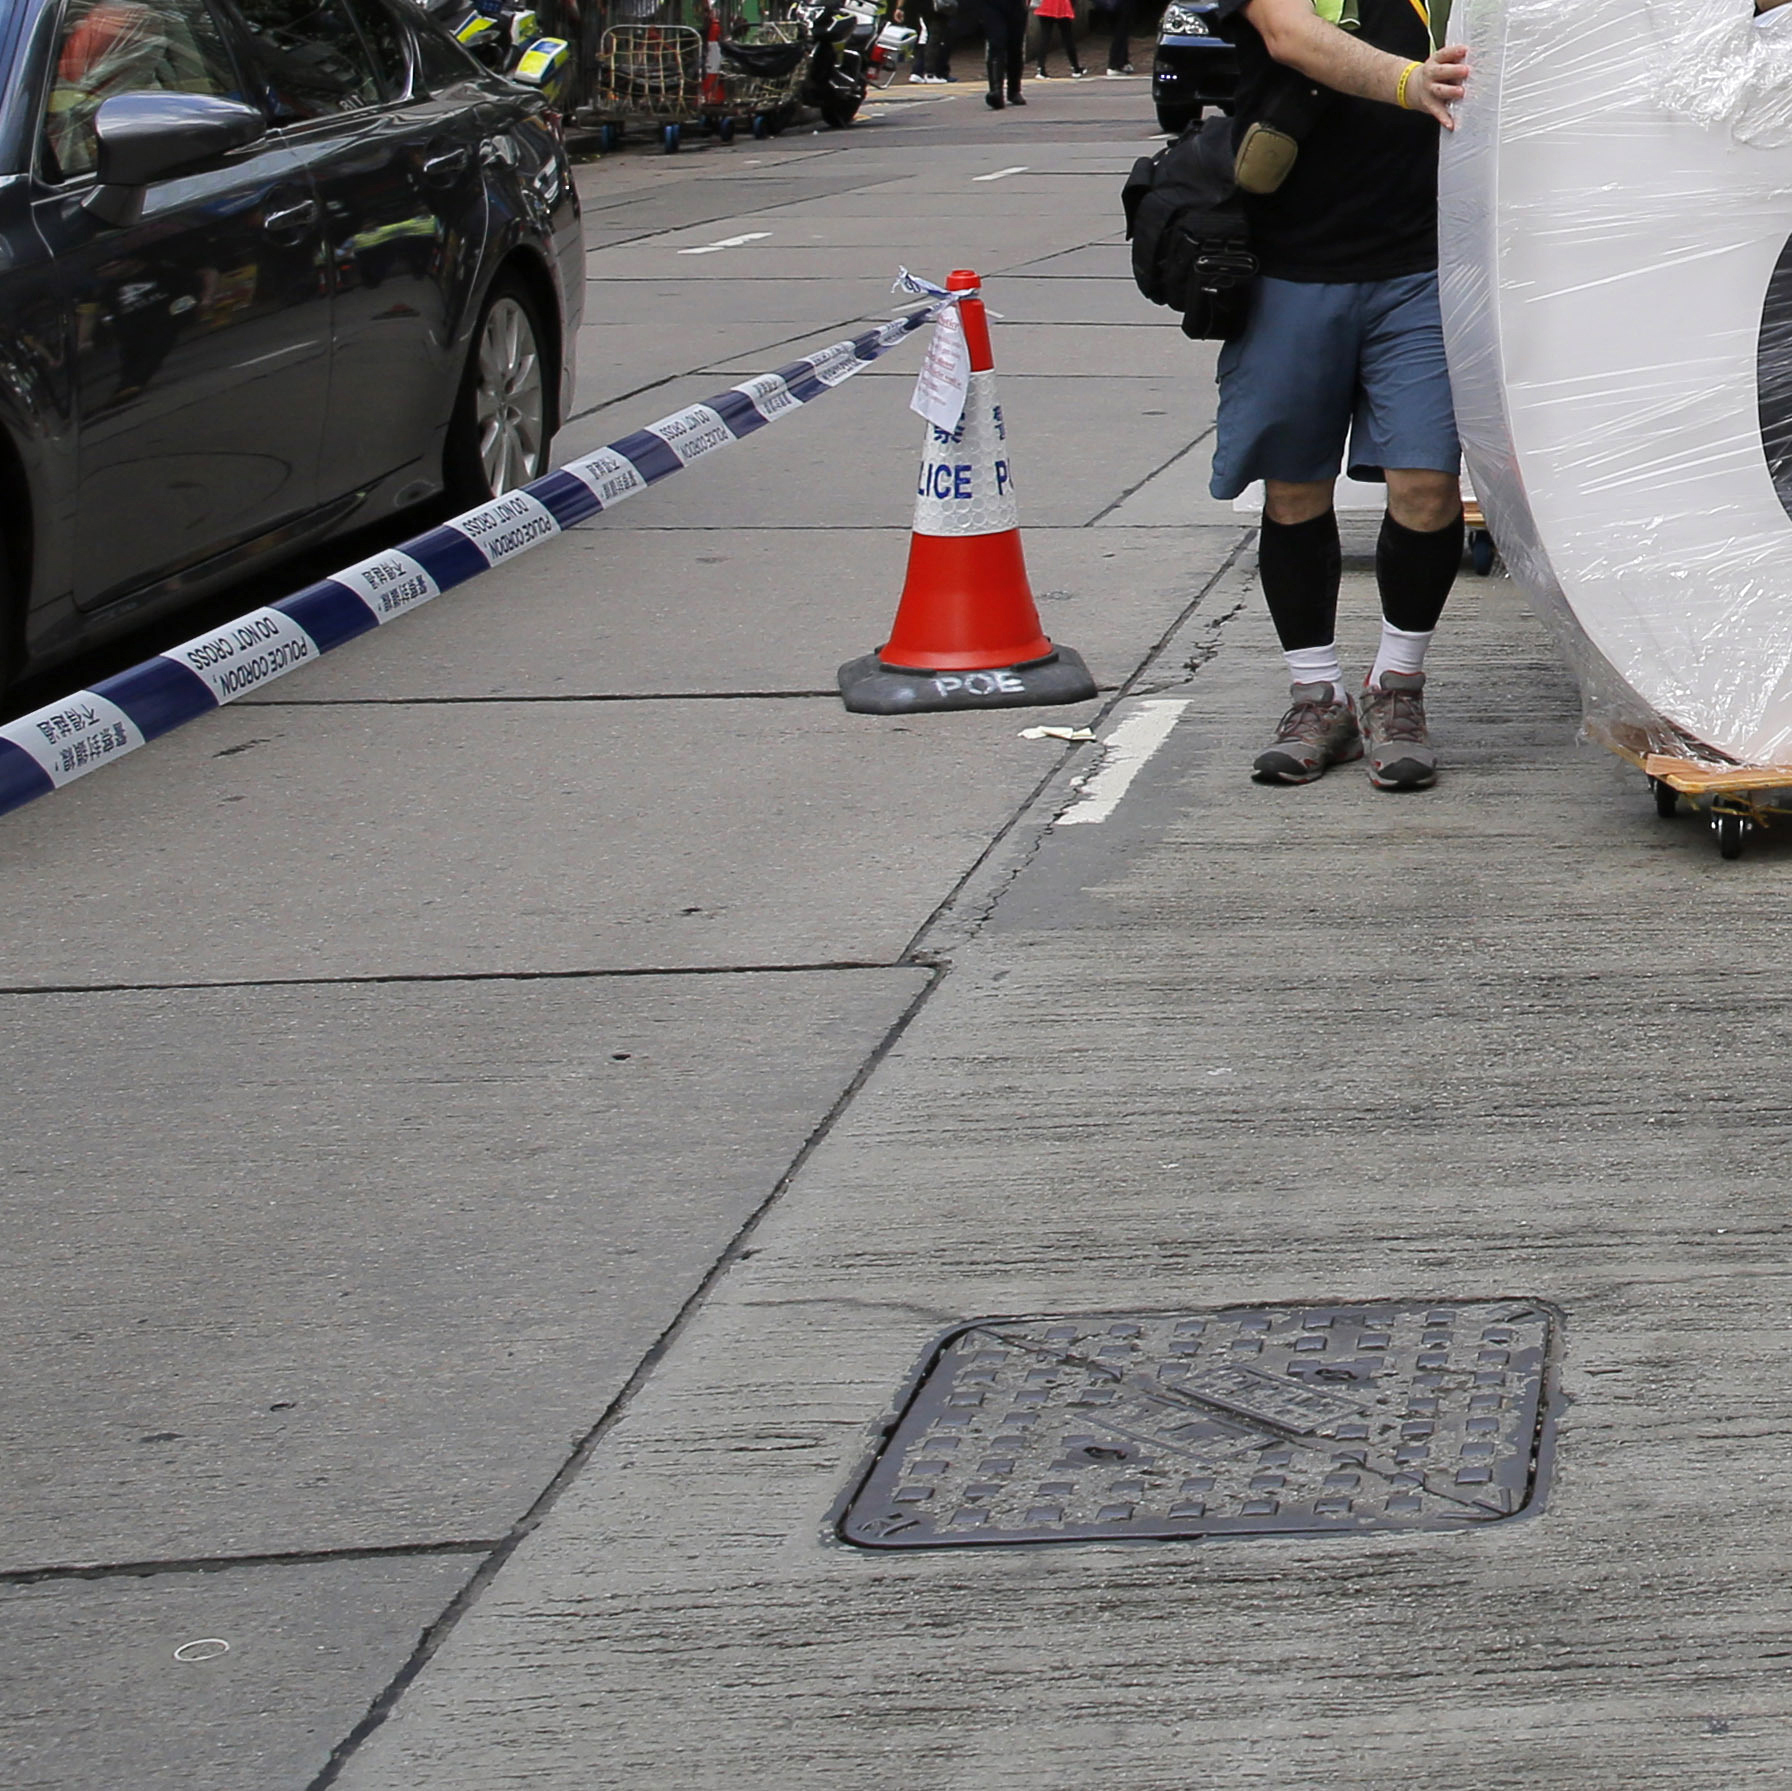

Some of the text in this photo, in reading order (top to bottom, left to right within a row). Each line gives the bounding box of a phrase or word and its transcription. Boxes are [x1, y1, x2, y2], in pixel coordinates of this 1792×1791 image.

[186, 617, 279, 670] DO NOT CROSS
[268, 636, 309, 672] POLICE
[932, 671, 1025, 696] POE
